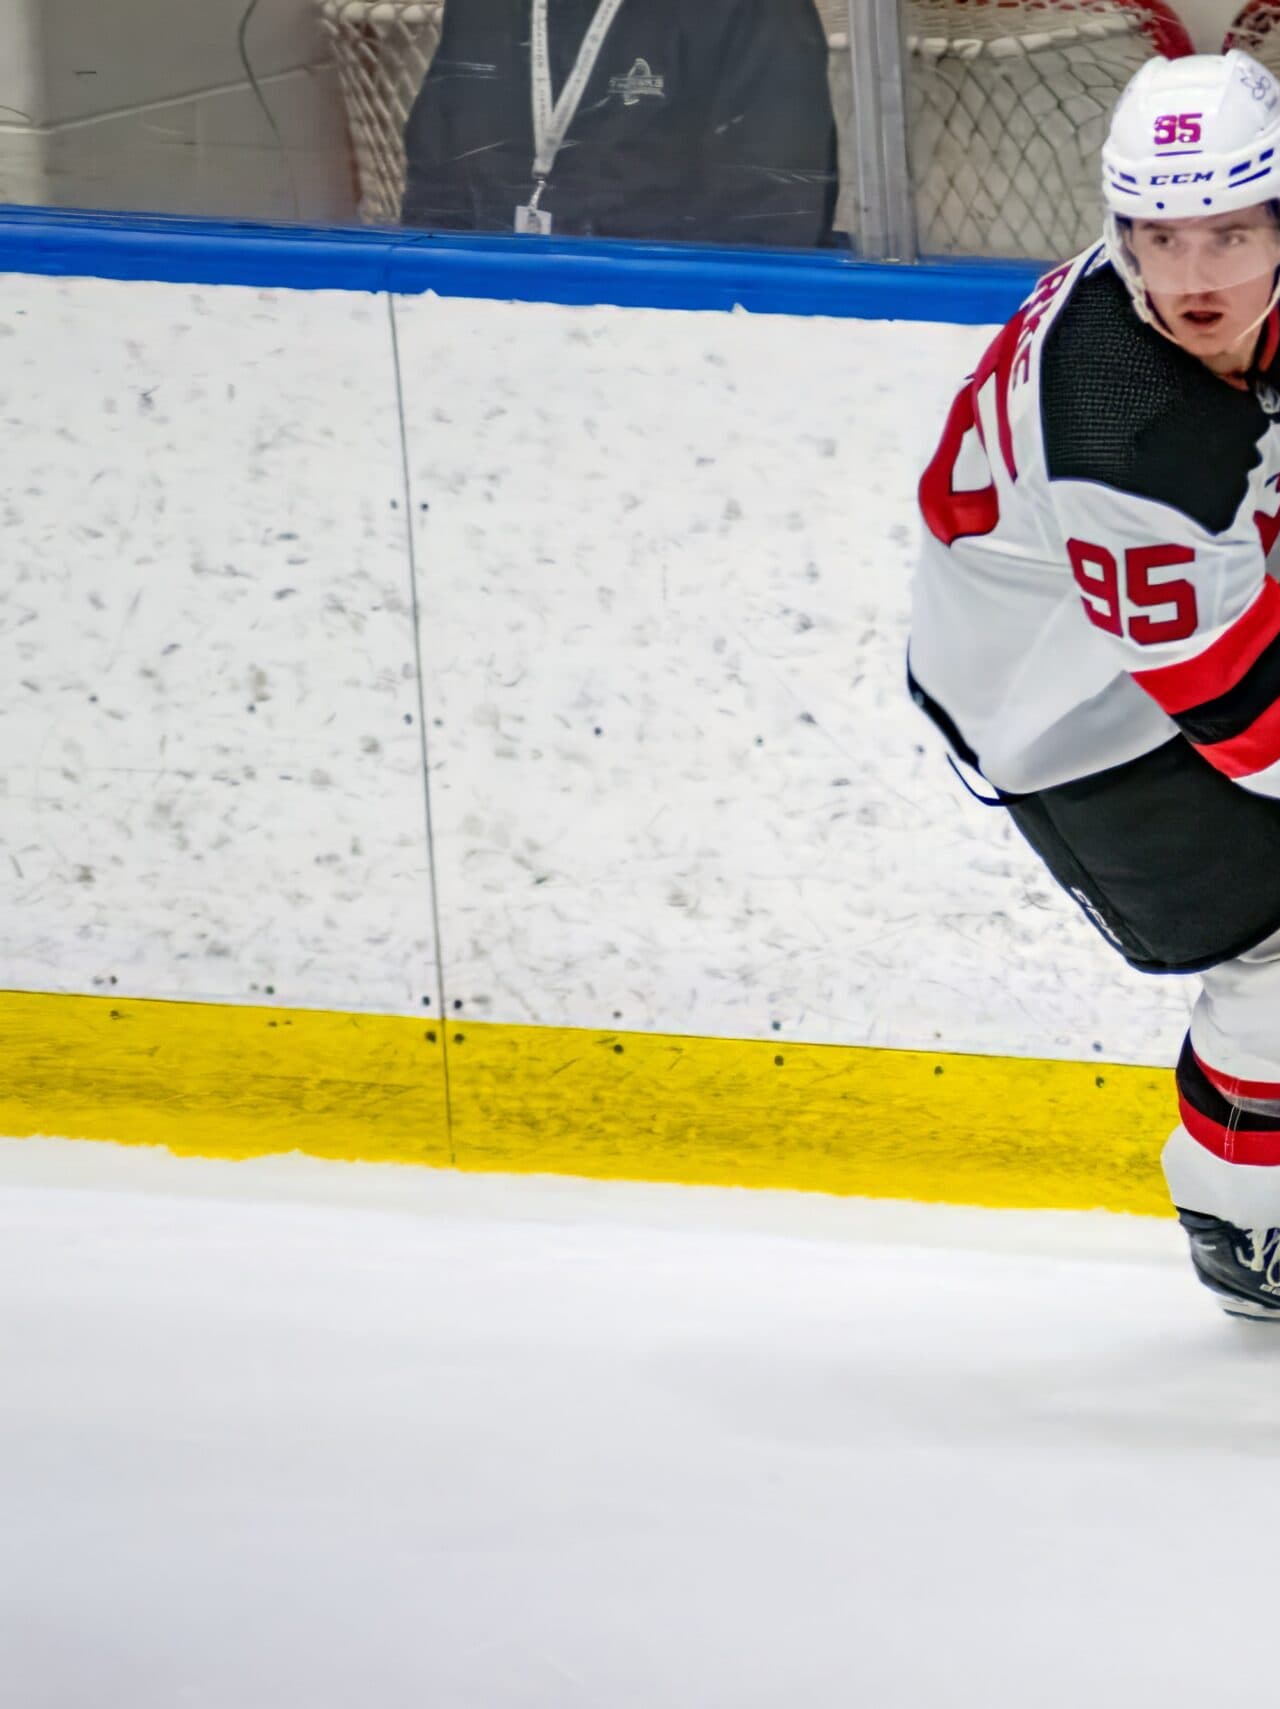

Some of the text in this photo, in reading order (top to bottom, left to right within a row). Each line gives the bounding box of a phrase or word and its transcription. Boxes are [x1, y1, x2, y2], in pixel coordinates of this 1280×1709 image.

[1154, 113, 1202, 145] 95
[1150, 171, 1214, 185] CCM
[1066, 537, 1199, 646] 95
